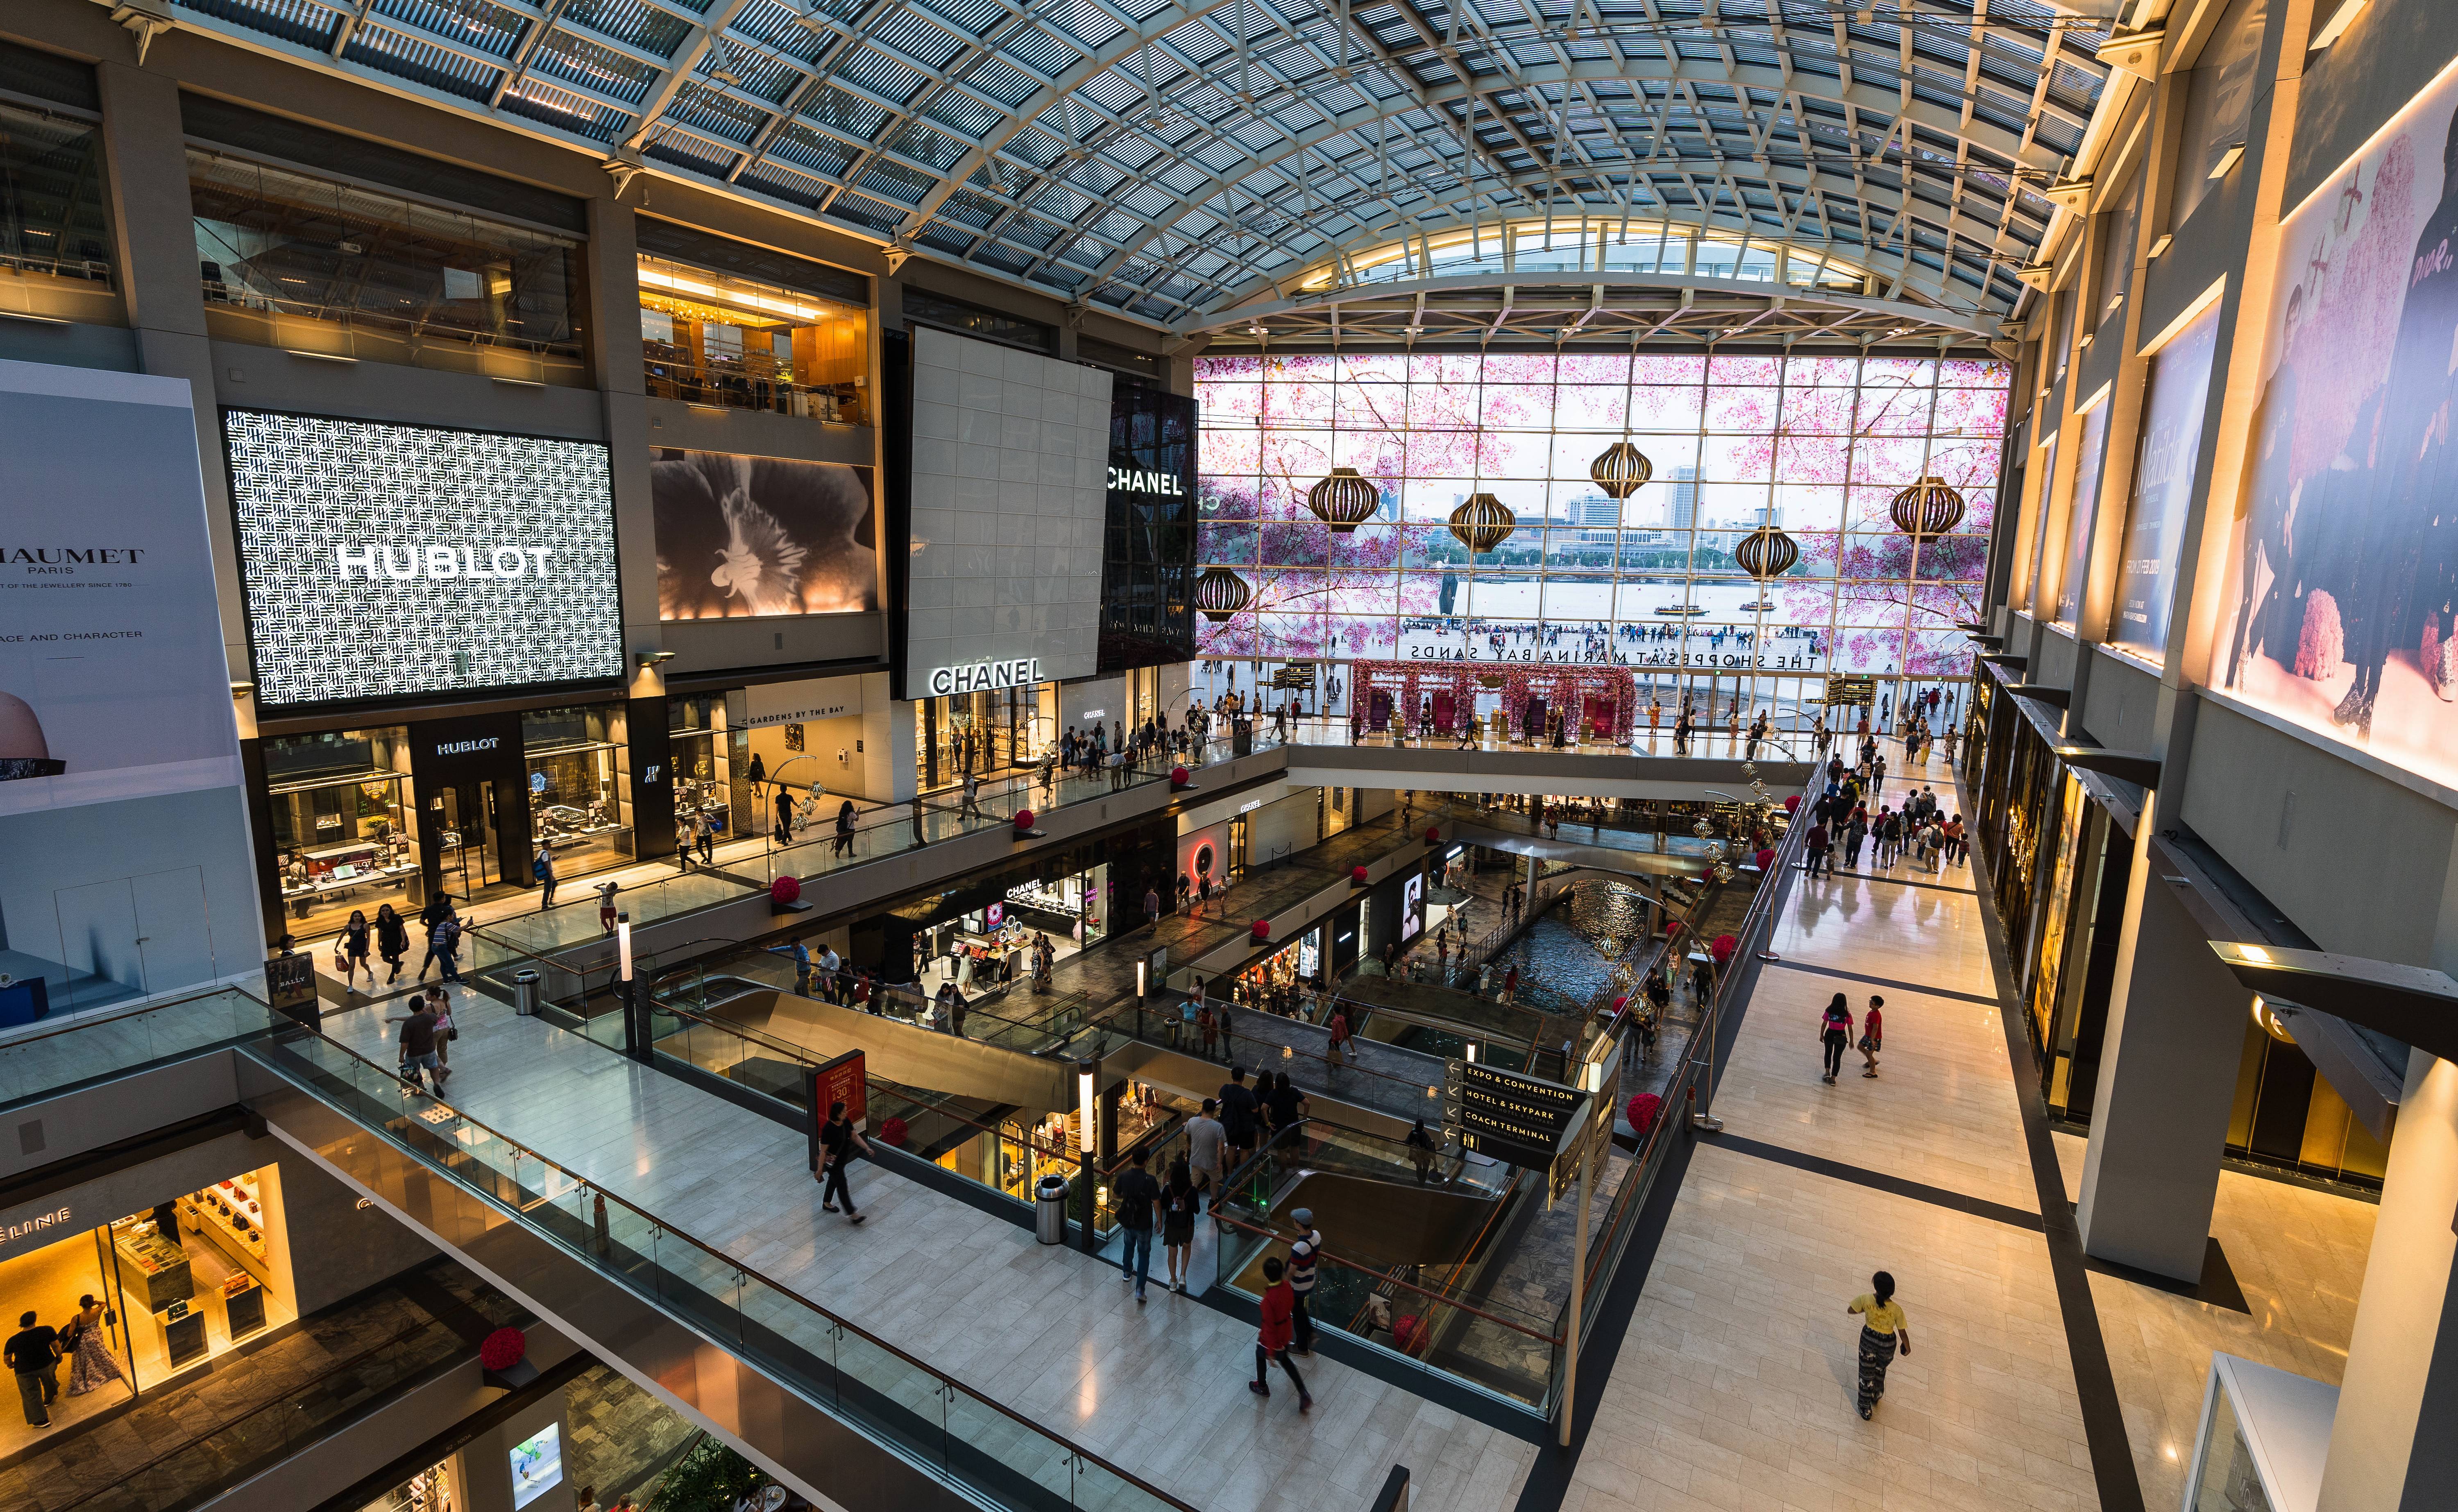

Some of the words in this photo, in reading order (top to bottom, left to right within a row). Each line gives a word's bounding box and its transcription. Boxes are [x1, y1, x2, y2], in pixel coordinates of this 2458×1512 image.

[2134, 424, 2181, 497] Matilda
[1108, 467, 1182, 495] CHANEL
[337, 545, 552, 579] HUBLOT
[2125, 560, 2137, 574] FROM
[2136, 559, 2142, 574] 21
[2140, 559, 2150, 575] FEB
[2148, 559, 2160, 575] 2019
[63, 631, 142, 640] CHARACTER
[933, 660, 1044, 694] CHANEL
[750, 713, 792, 724] GARDENS
[1084, 709, 1105, 719] CHANEL
[438, 738, 499, 755] HUBLOT
[1241, 799, 1261, 813] CHANEL
[1007, 879, 1042, 898] CHANEL
[1085, 887, 1098, 896] HANCE
[1085, 894, 1098, 903] HANEL
[280, 977, 305, 987] BALLY
[1468, 1068, 1491, 1080] EXPO
[1505, 1079, 1573, 1100] CONVENTION
[837, 1087, 847, 1098] 30
[1524, 1092, 1566, 1105] KONVENSYEN
[1467, 1090, 1496, 1104] HOTEL
[1509, 1103, 1554, 1119] SKYPARK
[1499, 1108, 1518, 1117] HOTEL
[1527, 1116, 1554, 1125] SKYPARK
[1466, 1112, 1497, 1126] COACH
[1500, 1123, 1550, 1141] TERMINAL
[1486, 1126, 1515, 1138] TERMINAL
